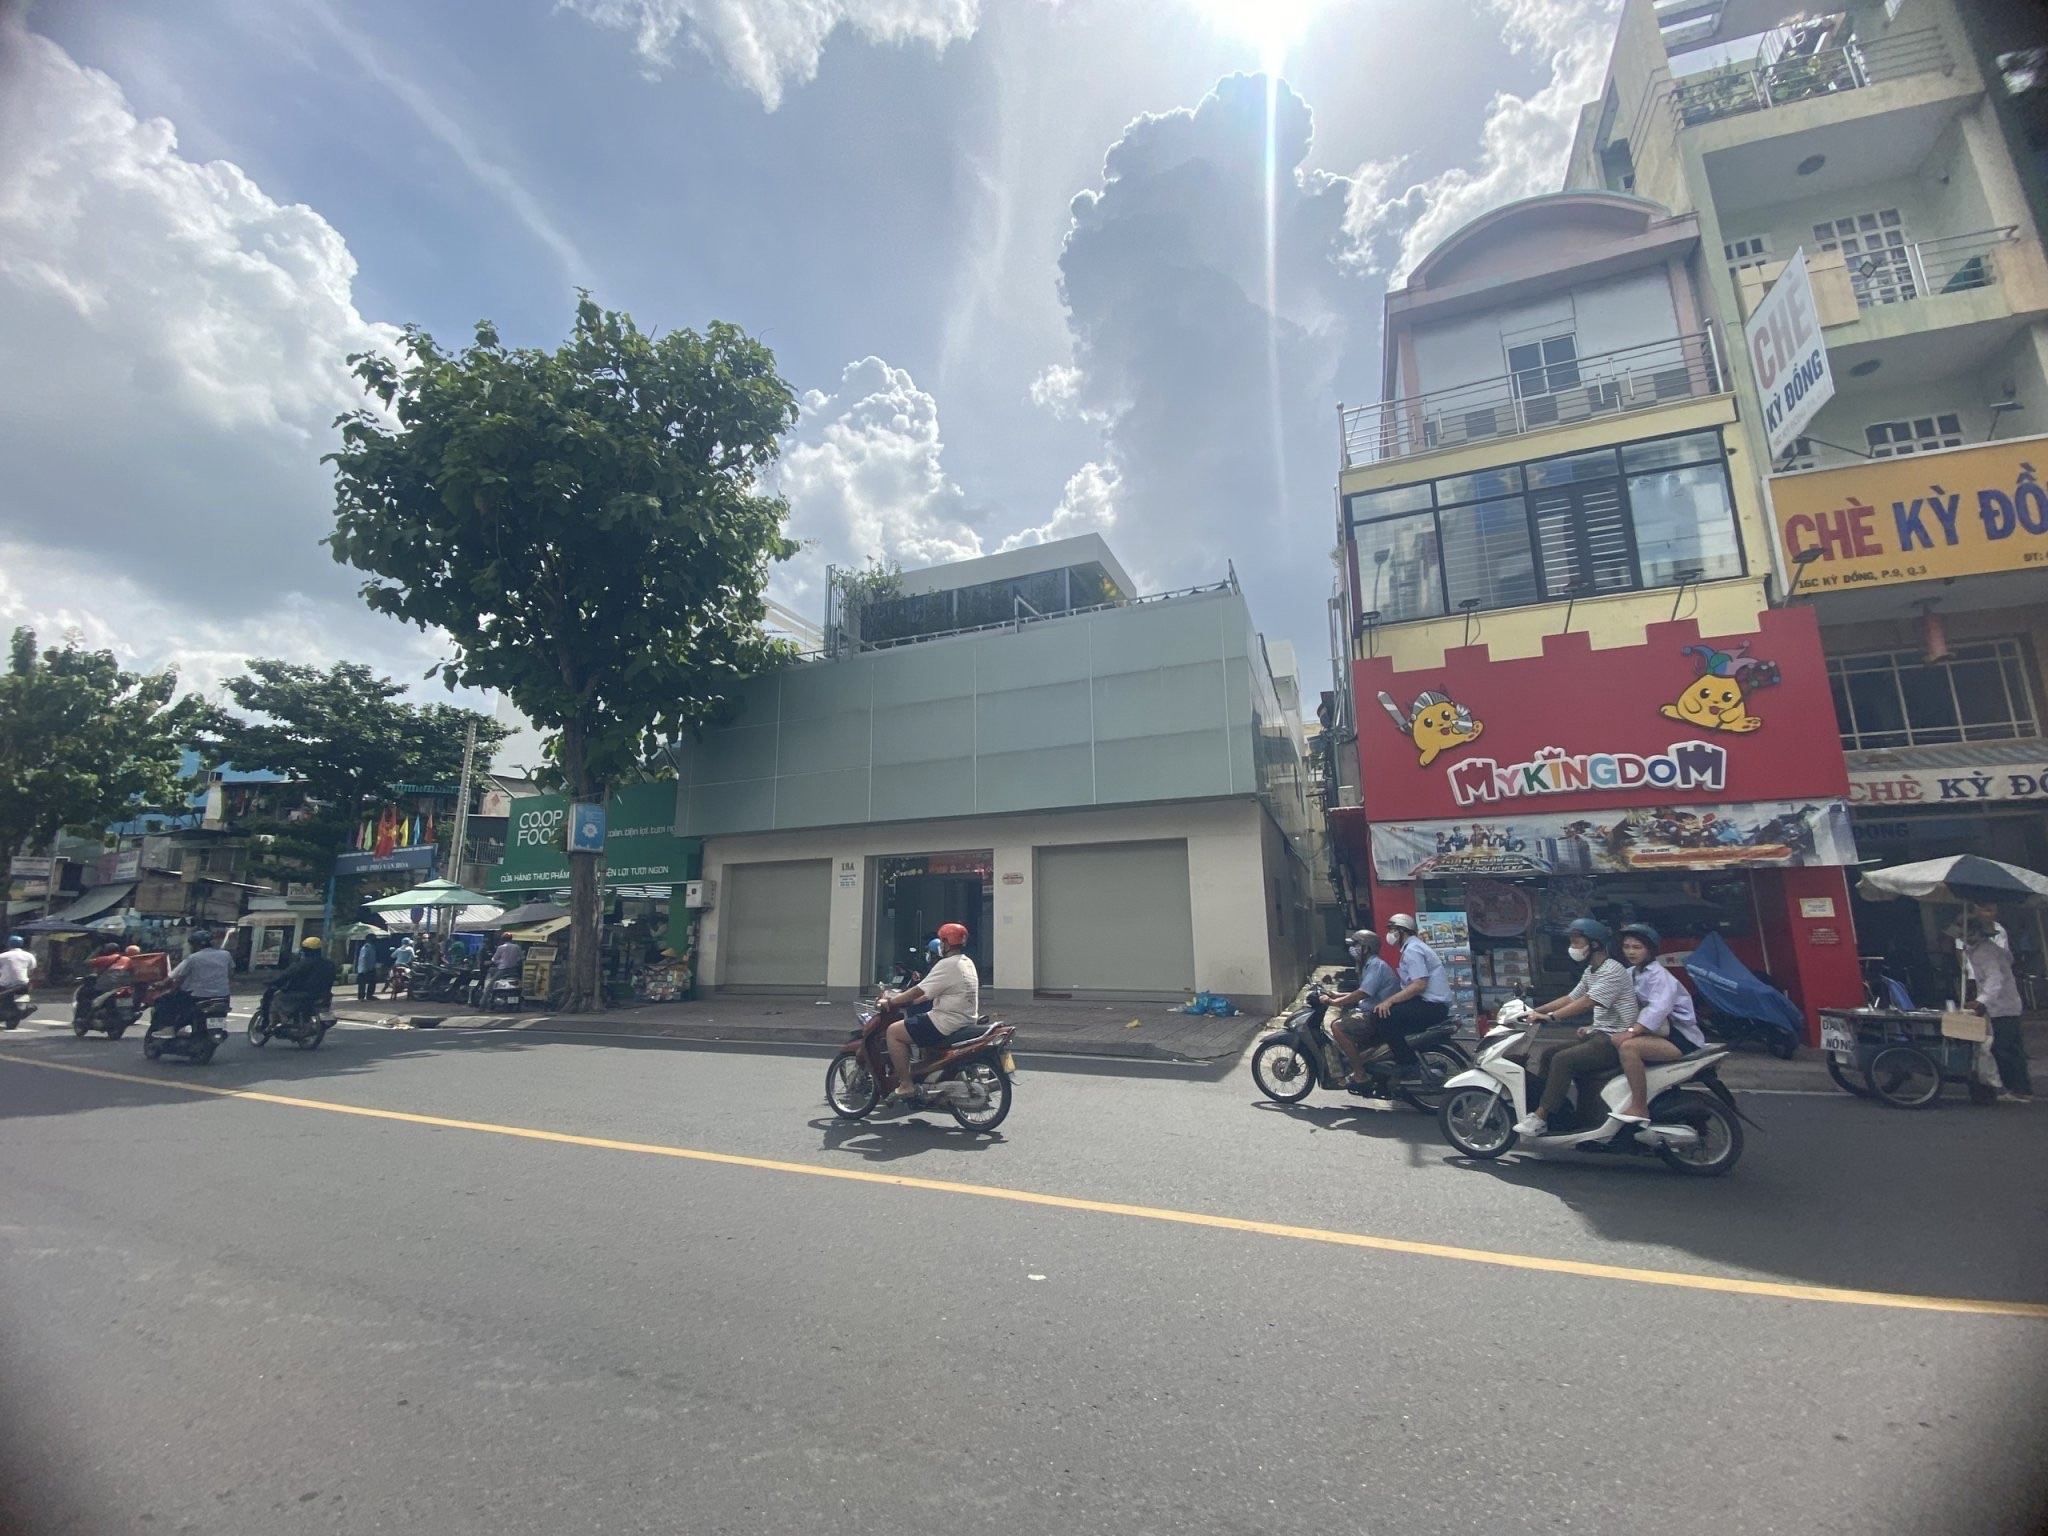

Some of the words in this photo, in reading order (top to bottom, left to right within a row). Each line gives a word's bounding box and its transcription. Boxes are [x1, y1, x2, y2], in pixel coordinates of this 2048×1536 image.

[1784, 496, 1884, 562] CHÈ
[1891, 485, 1961, 552] KỲ
[1976, 462, 2048, 541] ĐỒ
[1449, 741, 1726, 805] MYKINGDOM
[1848, 774, 1924, 802] CHÈ
[1937, 771, 1993, 799] KỲ
[519, 810, 563, 828] CO.OP
[517, 828, 560, 847] FOO
